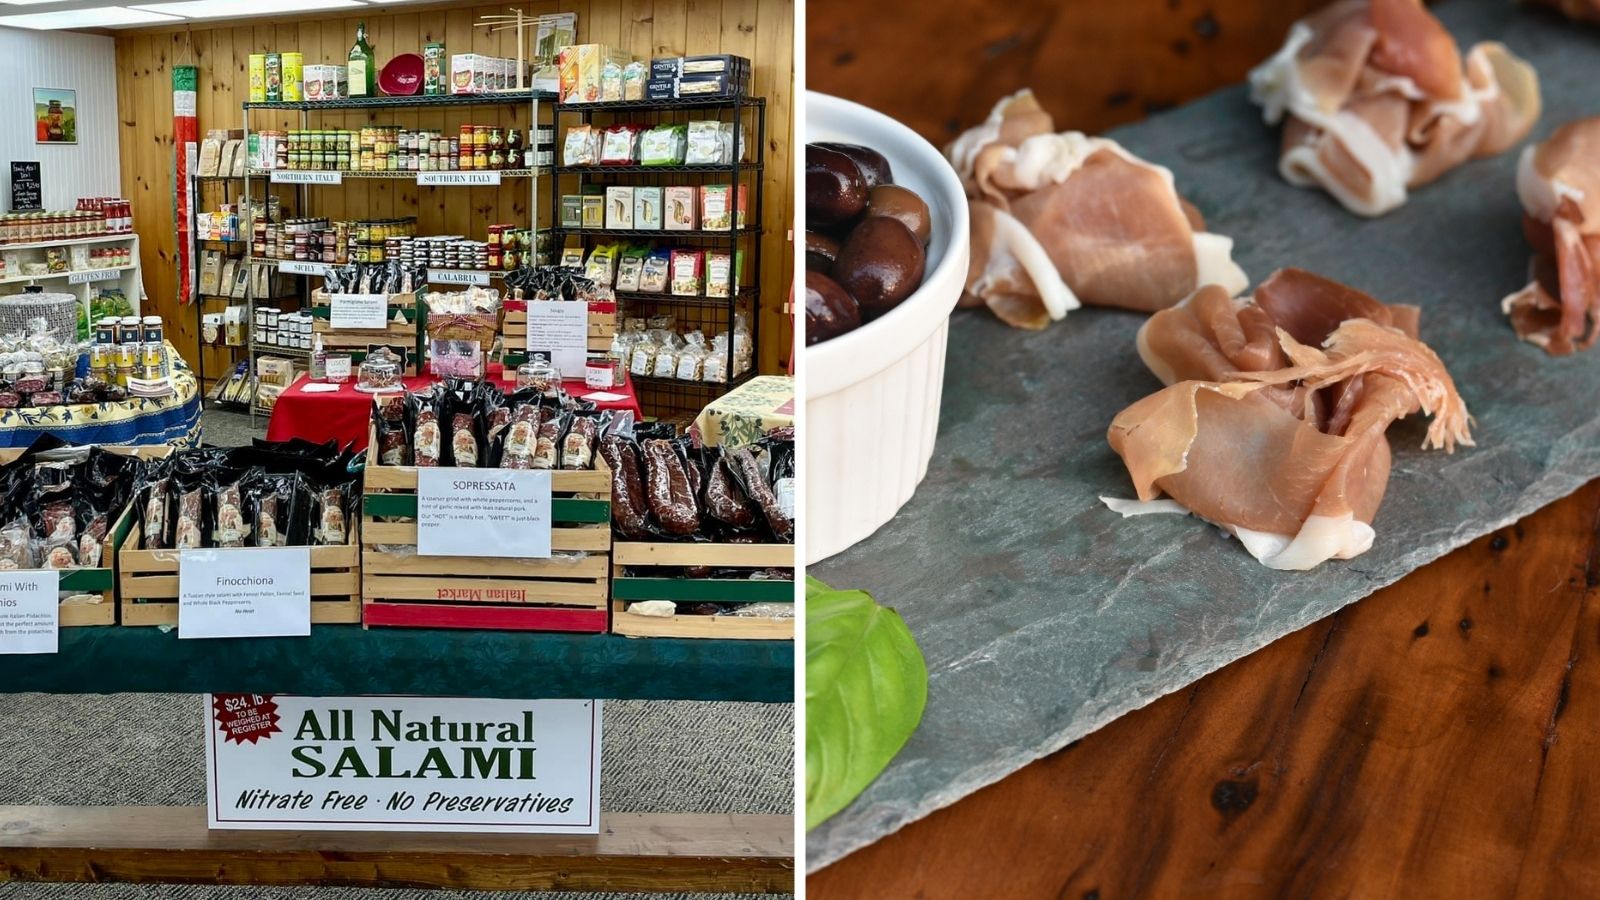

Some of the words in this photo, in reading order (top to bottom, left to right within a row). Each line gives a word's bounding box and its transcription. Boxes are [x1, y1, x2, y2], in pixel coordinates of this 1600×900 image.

[277, 173, 313, 181] NORTHERN
[315, 174, 335, 182] ITALY
[71, 272, 99, 282] GLUTEN
[102, 270, 119, 279] FREE
[438, 272, 478, 282] CALABRIA
[453, 481, 516, 490] SOPRESSATA
[14, 582, 38, 591] With
[217, 576, 273, 586] Finocchiona
[437, 588, 482, 600] Market
[486, 589, 527, 602] Italian
[224, 696, 251, 712] $24.
[252, 694, 268, 705] lb.
[226, 716, 260, 728] WEIGHED
[232, 721, 272, 735] REGISTER
[294, 709, 355, 741] All
[370, 710, 535, 742] Natural
[291, 746, 536, 779] SALAMI
[235, 790, 313, 810] Nitrate
[321, 790, 368, 810] Free
[386, 792, 414, 811] No
[422, 792, 574, 813] Preservatives
